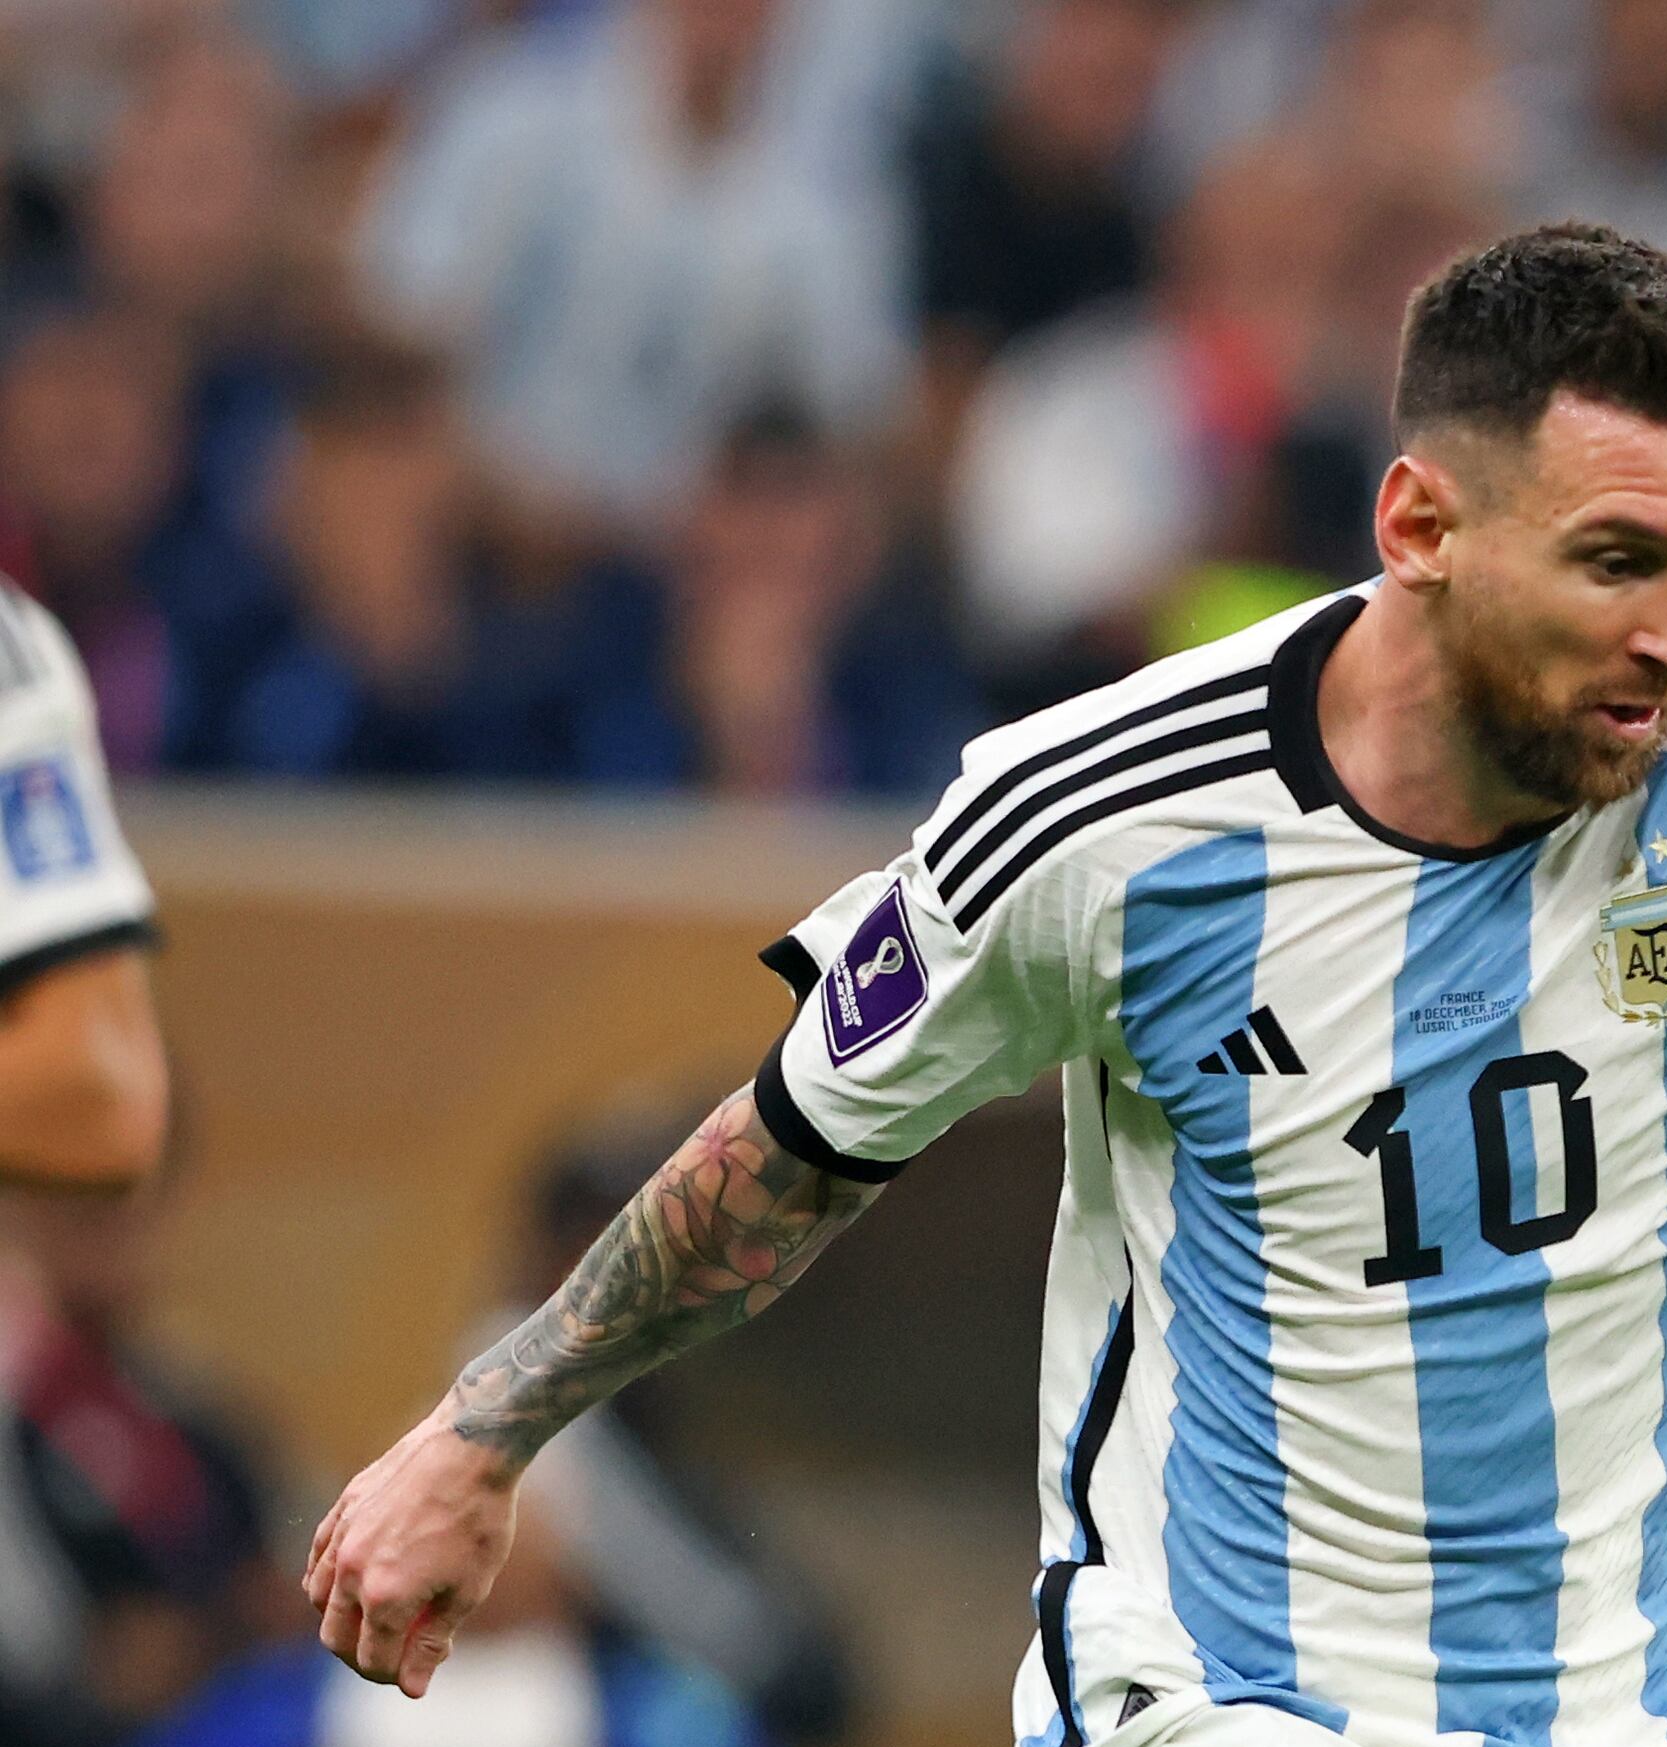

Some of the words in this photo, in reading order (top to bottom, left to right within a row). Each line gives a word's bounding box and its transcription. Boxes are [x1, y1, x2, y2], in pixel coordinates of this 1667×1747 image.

[1440, 991, 1485, 1005] FRANCE
[850, 1005, 863, 1027] CUP
[1409, 1008, 1421, 1022] 18
[1425, 1004, 1487, 1020] DECEMBER
[1416, 1021, 1458, 1034] LUSAIL
[1461, 1007, 1511, 1028] STADIUM
[1343, 1050, 1598, 1288] 10
